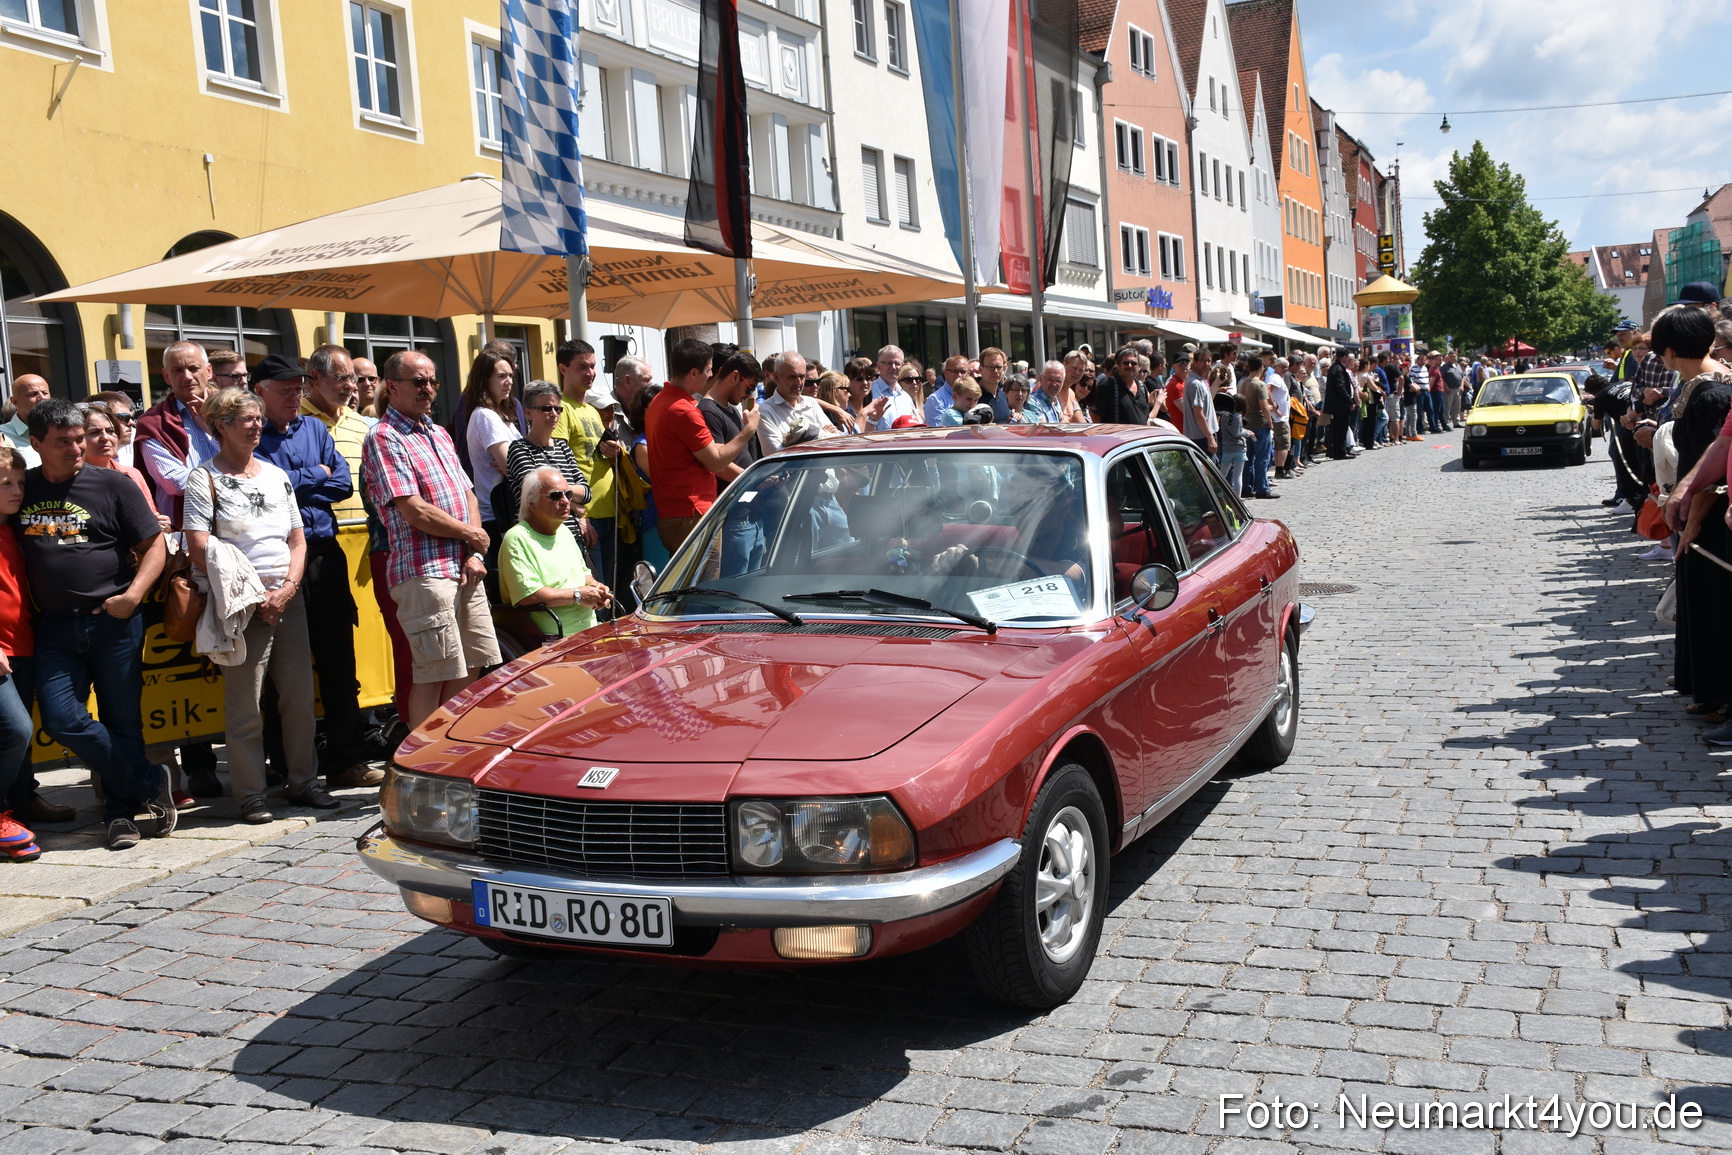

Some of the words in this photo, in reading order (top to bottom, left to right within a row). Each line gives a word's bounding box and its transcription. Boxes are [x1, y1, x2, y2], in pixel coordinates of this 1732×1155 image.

[1114, 290, 1146, 301] sutor.
[544, 341, 555, 354] 24
[63, 501, 91, 520] RIVER
[21, 513, 87, 525] SUMMER
[1021, 582, 1059, 595] 218
[583, 770, 613, 784] NSU
[479, 907, 485, 918] D
[491, 888, 548, 929] RID
[566, 898, 611, 936] RO
[620, 902, 664, 939] 80
